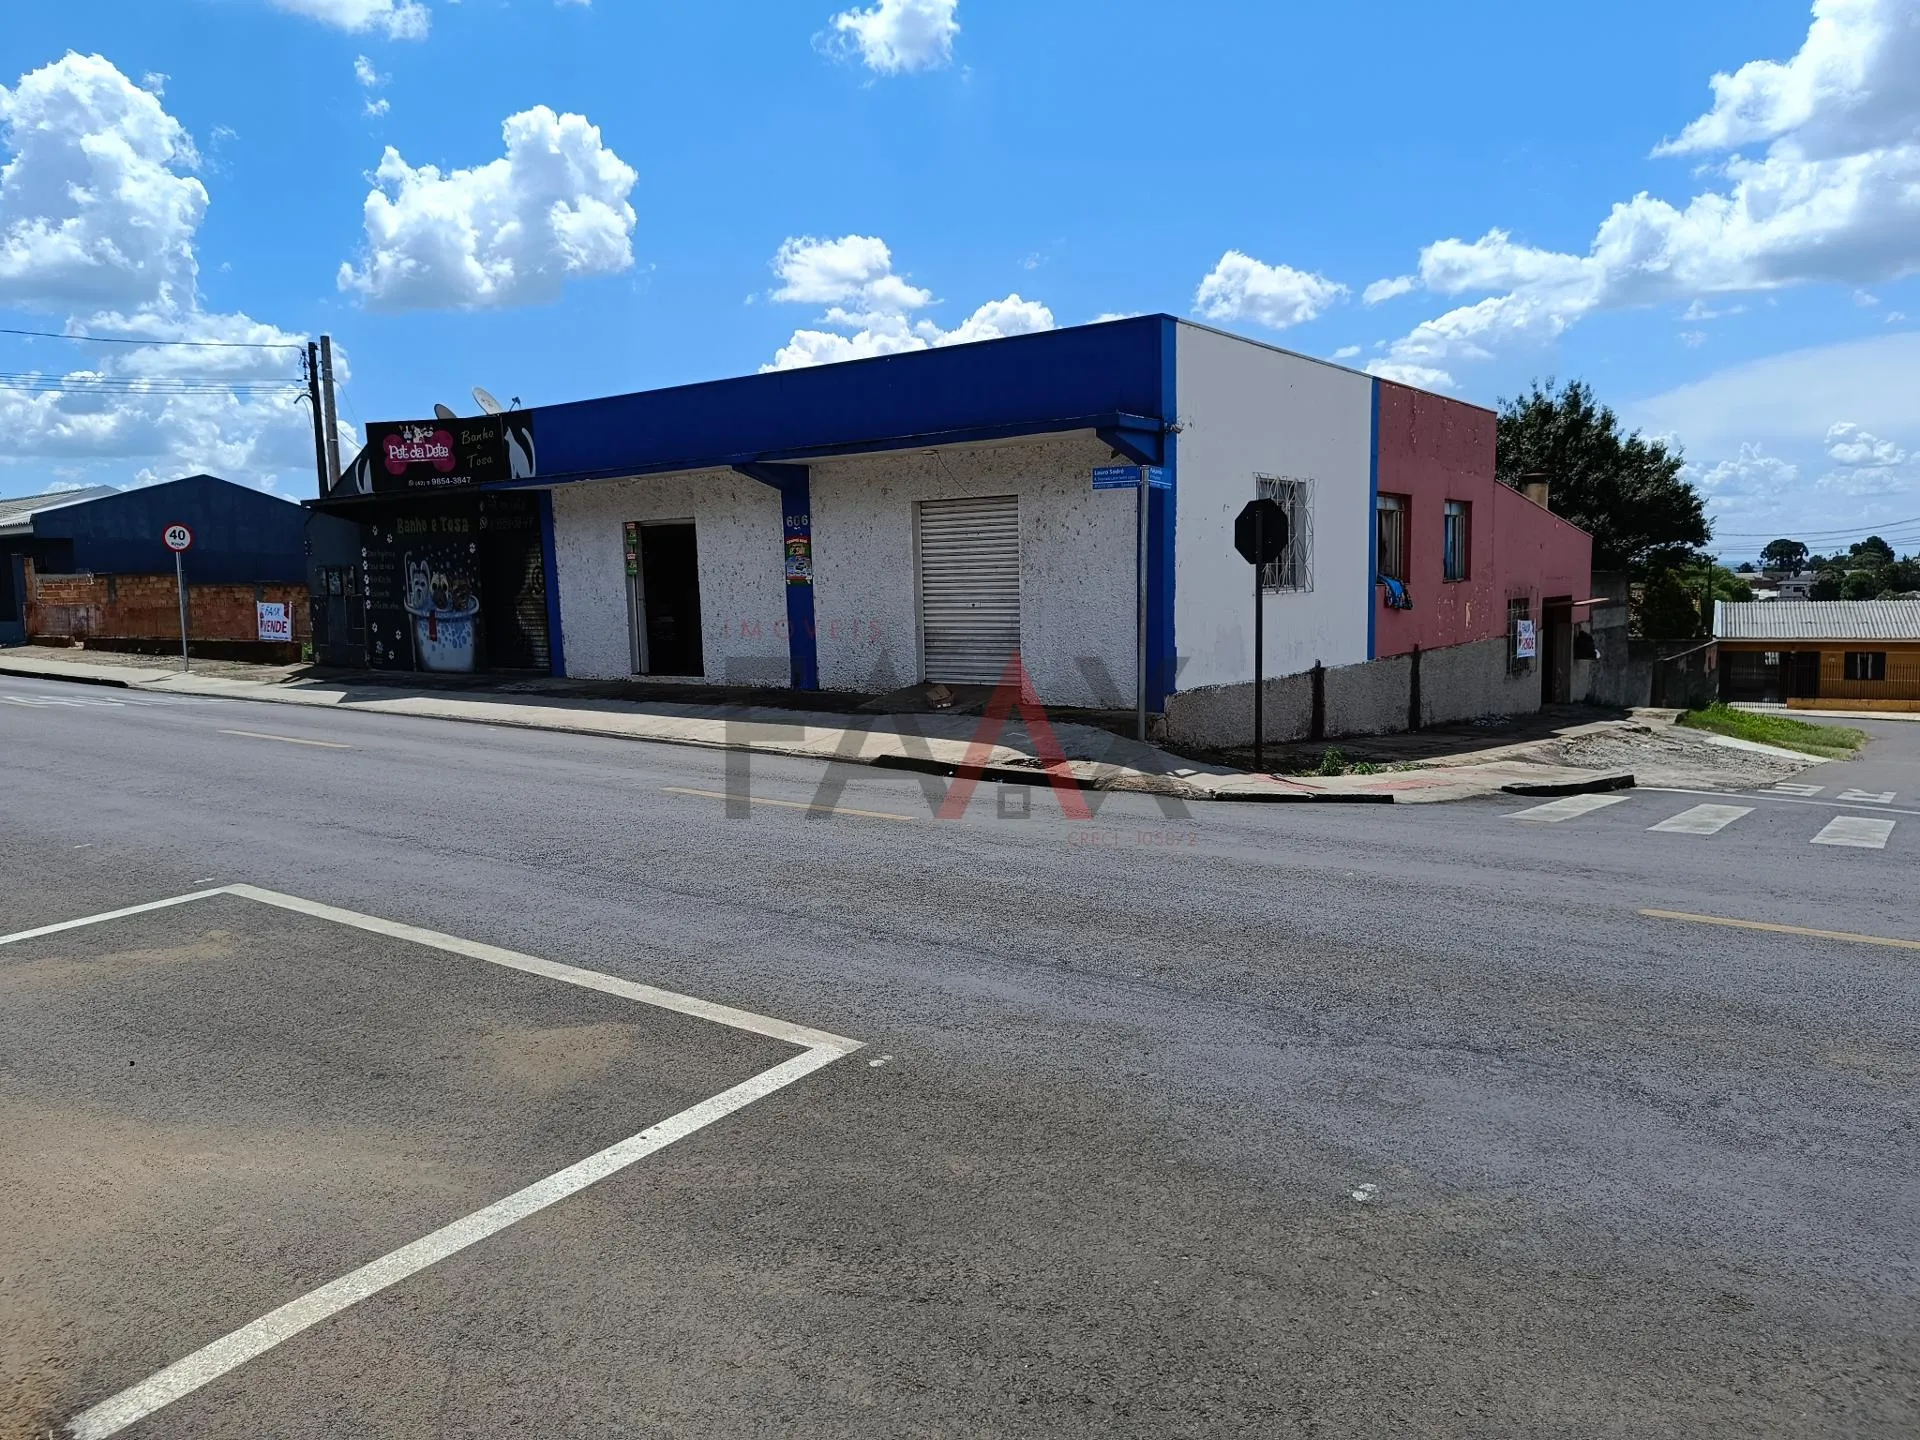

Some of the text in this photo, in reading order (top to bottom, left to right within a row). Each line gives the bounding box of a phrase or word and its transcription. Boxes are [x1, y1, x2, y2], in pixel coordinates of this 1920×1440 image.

[461, 427, 494, 445] Banho
[389, 445, 409, 459] Pet
[410, 444, 425, 458] da
[466, 453, 493, 469] Tosa
[431, 476, 472, 486] 9854-3847
[396, 516, 428, 535] Banho
[431, 517, 437, 532] e
[439, 516, 469, 534] Tosa
[786, 514, 809, 527] 606
[169, 529, 186, 541] 40
[260, 620, 287, 633] VENDE
